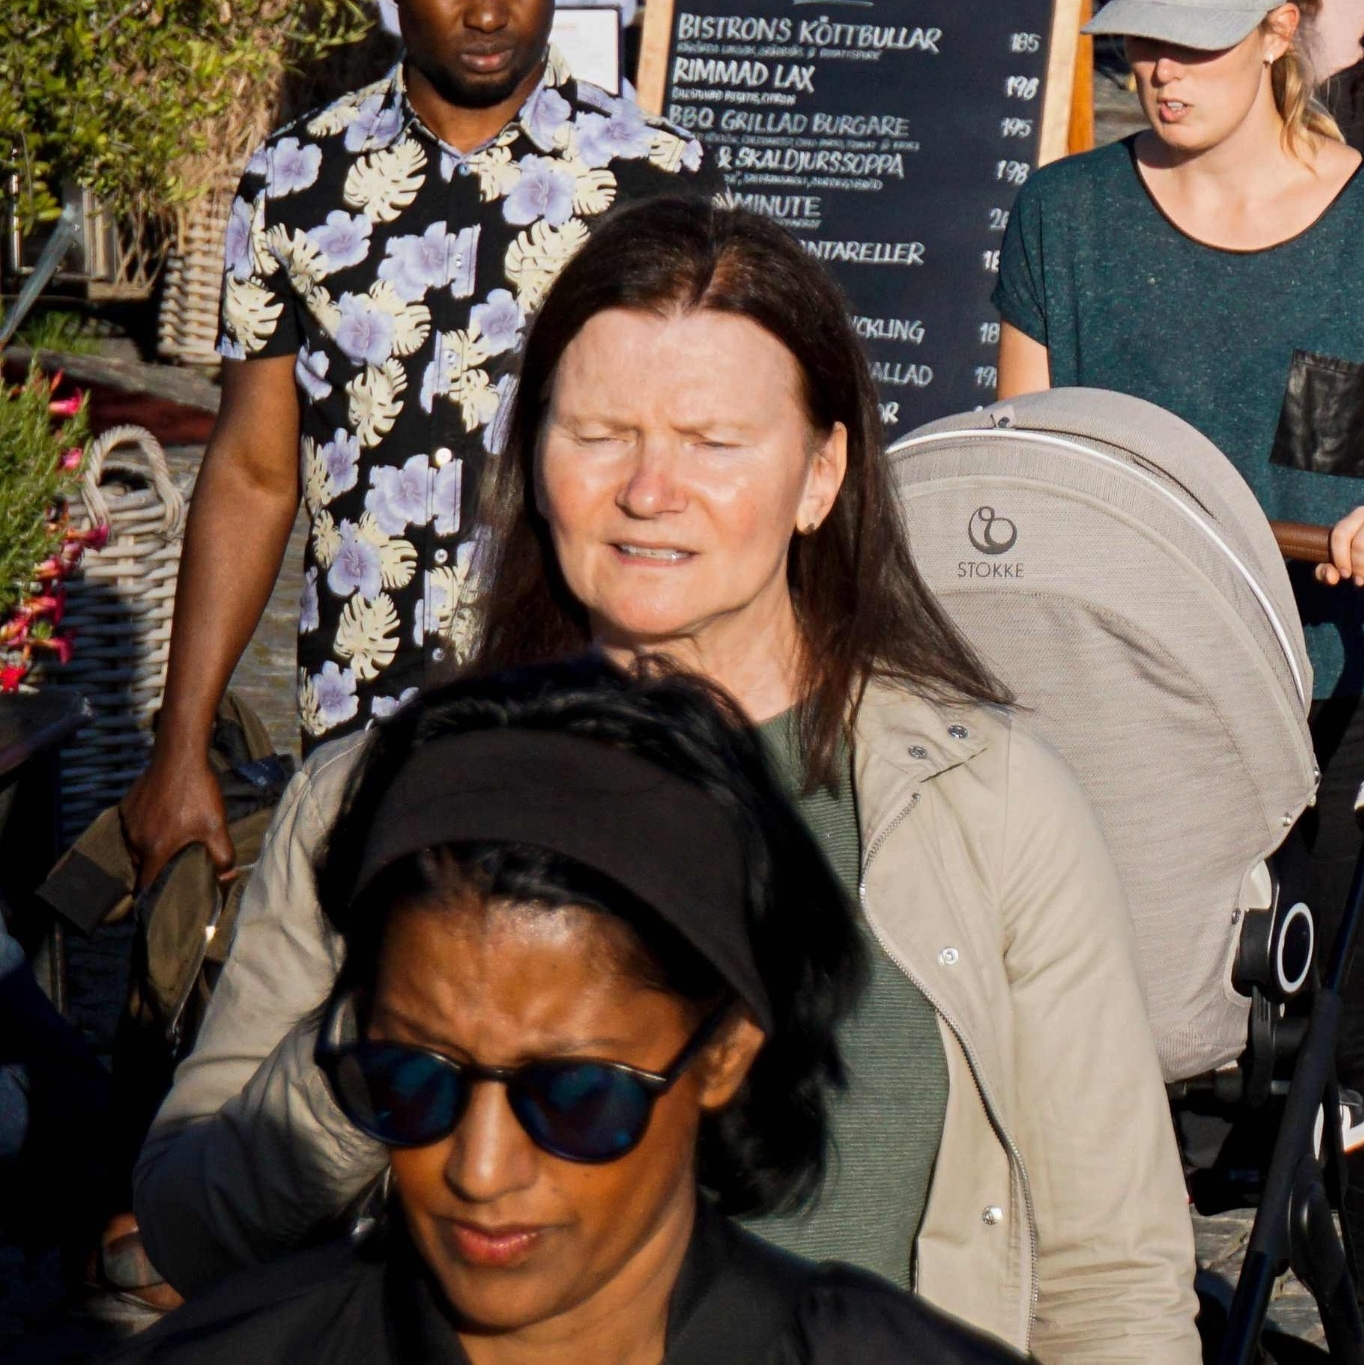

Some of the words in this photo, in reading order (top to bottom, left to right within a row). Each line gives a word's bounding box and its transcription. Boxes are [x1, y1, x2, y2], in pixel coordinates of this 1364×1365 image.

[678, 12, 793, 43] BISTRONS
[800, 15, 943, 55] KÖTTBULLAR
[1010, 32, 1042, 53] 185
[672, 56, 770, 88] RIMMAD
[773, 64, 816, 94] LAX
[1005, 76, 1040, 101] 198
[668, 103, 715, 130] BBQ
[720, 109, 808, 135] GRILLAD
[812, 112, 911, 138] BURGARE
[1001, 117, 1034, 138] 195
[996, 160, 1031, 186] 198
[800, 240, 927, 266] NTARELLER
[957, 561, 1025, 578] STOKKE
